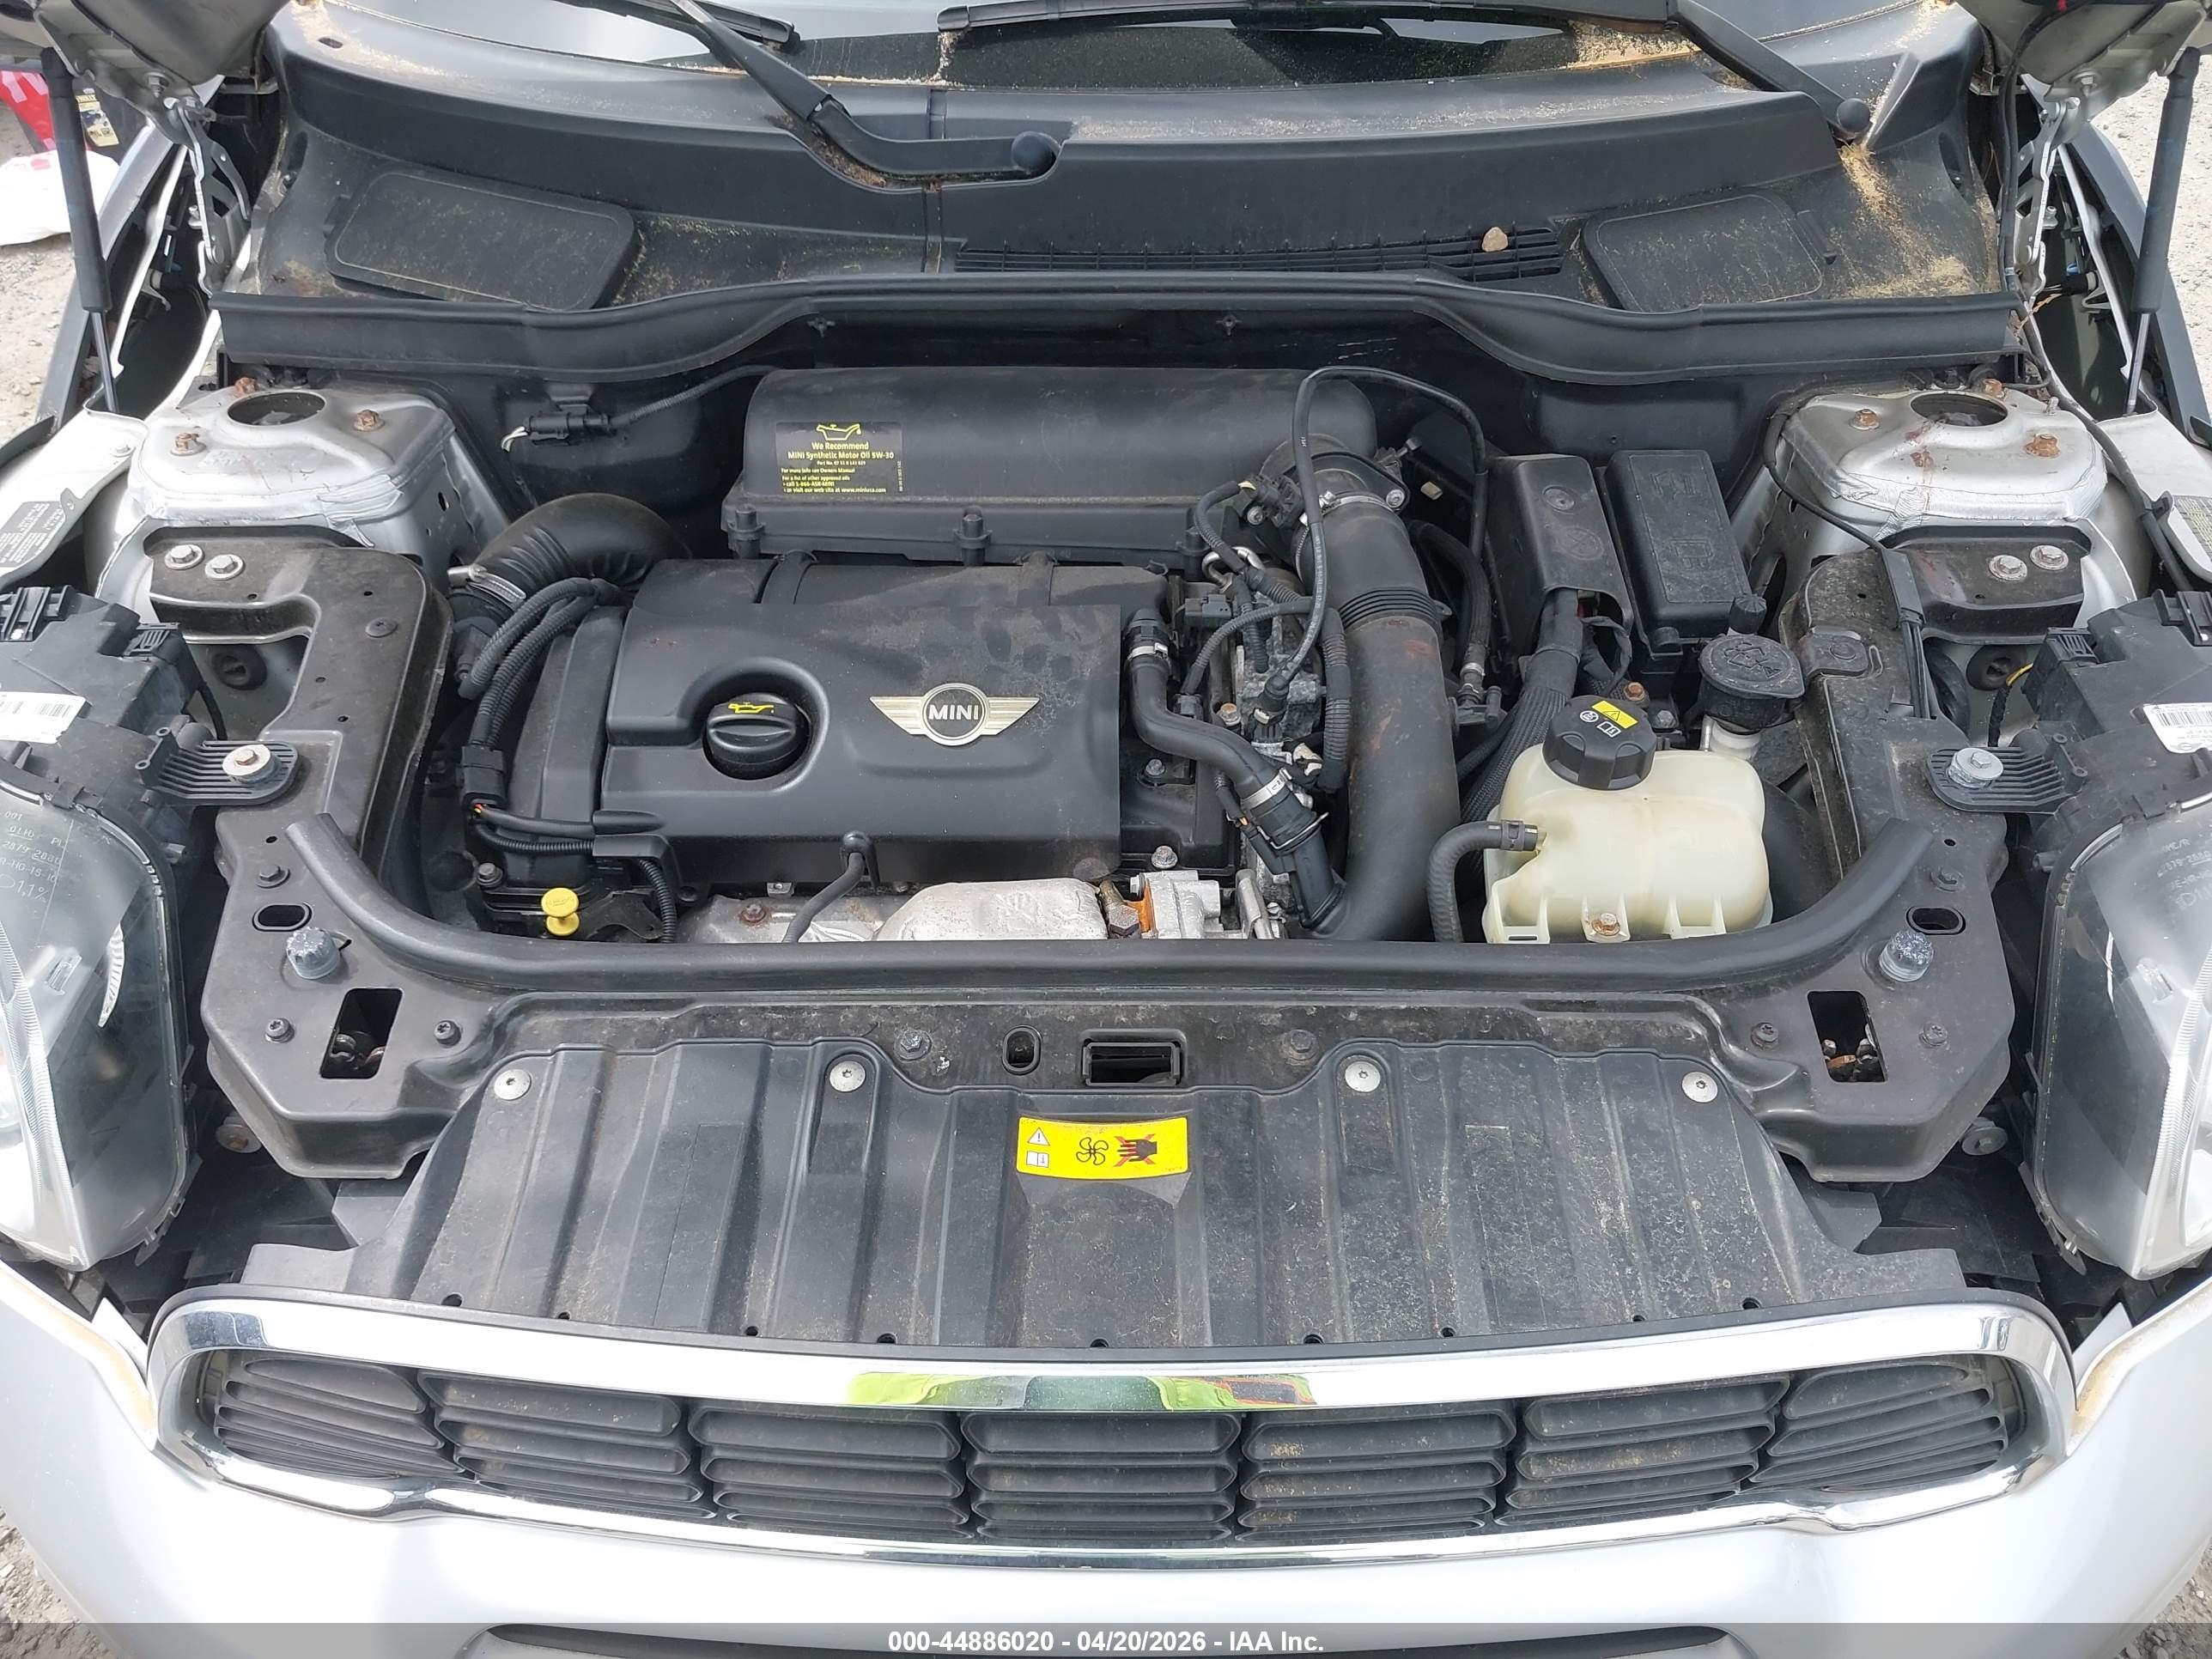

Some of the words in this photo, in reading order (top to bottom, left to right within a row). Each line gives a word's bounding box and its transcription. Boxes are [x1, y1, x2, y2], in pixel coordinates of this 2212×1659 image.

[811, 441, 823, 450] We
[825, 441, 869, 450] Recommend
[806, 451, 837, 461] Synthetic
[860, 451, 870, 459] Oil
[928, 704, 979, 720] MINI
